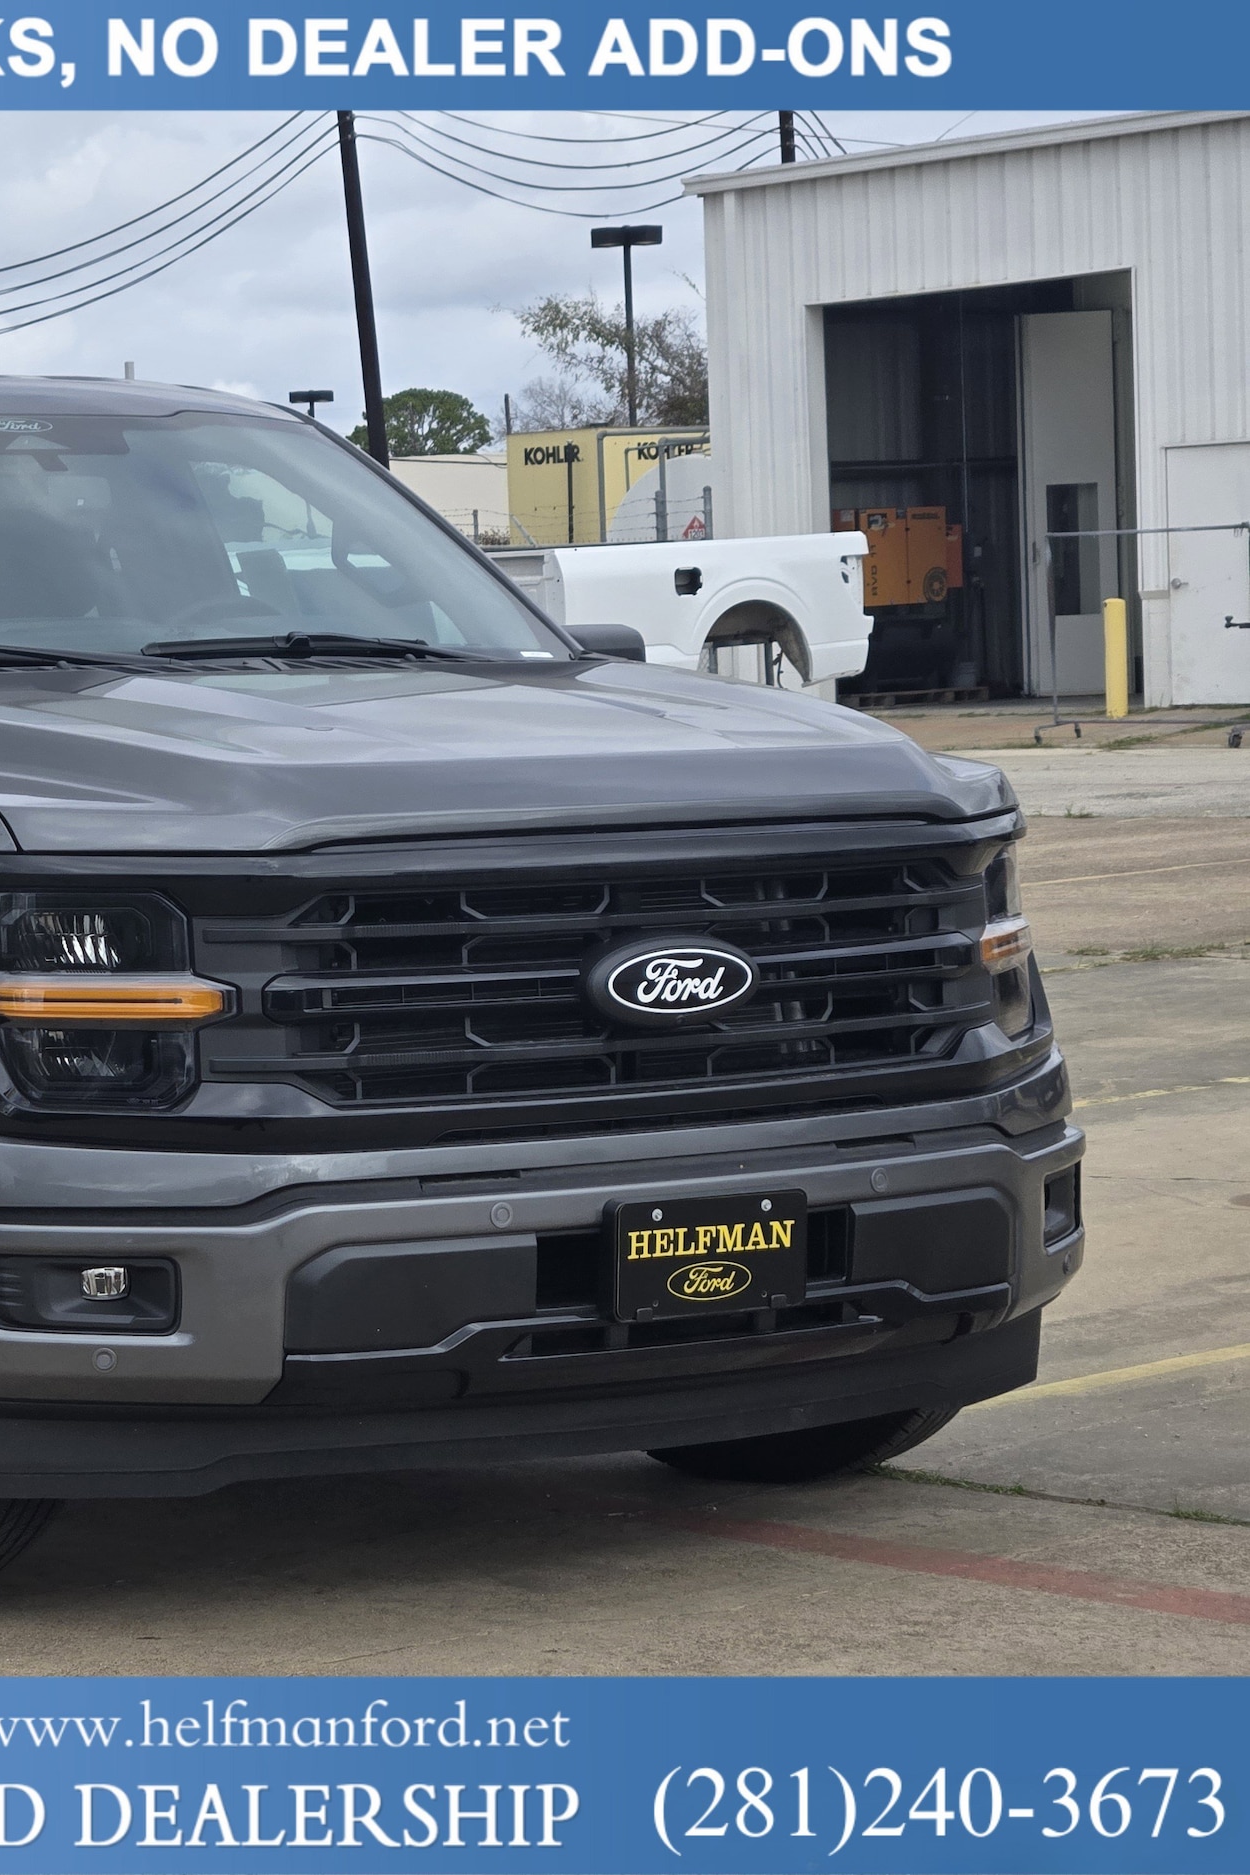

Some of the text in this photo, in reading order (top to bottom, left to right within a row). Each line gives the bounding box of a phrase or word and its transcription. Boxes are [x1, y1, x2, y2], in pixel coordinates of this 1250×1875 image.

[637, 958, 725, 1003] Ford
[627, 1219, 796, 1261] HELFMAN
[683, 1266, 737, 1294] Ford
